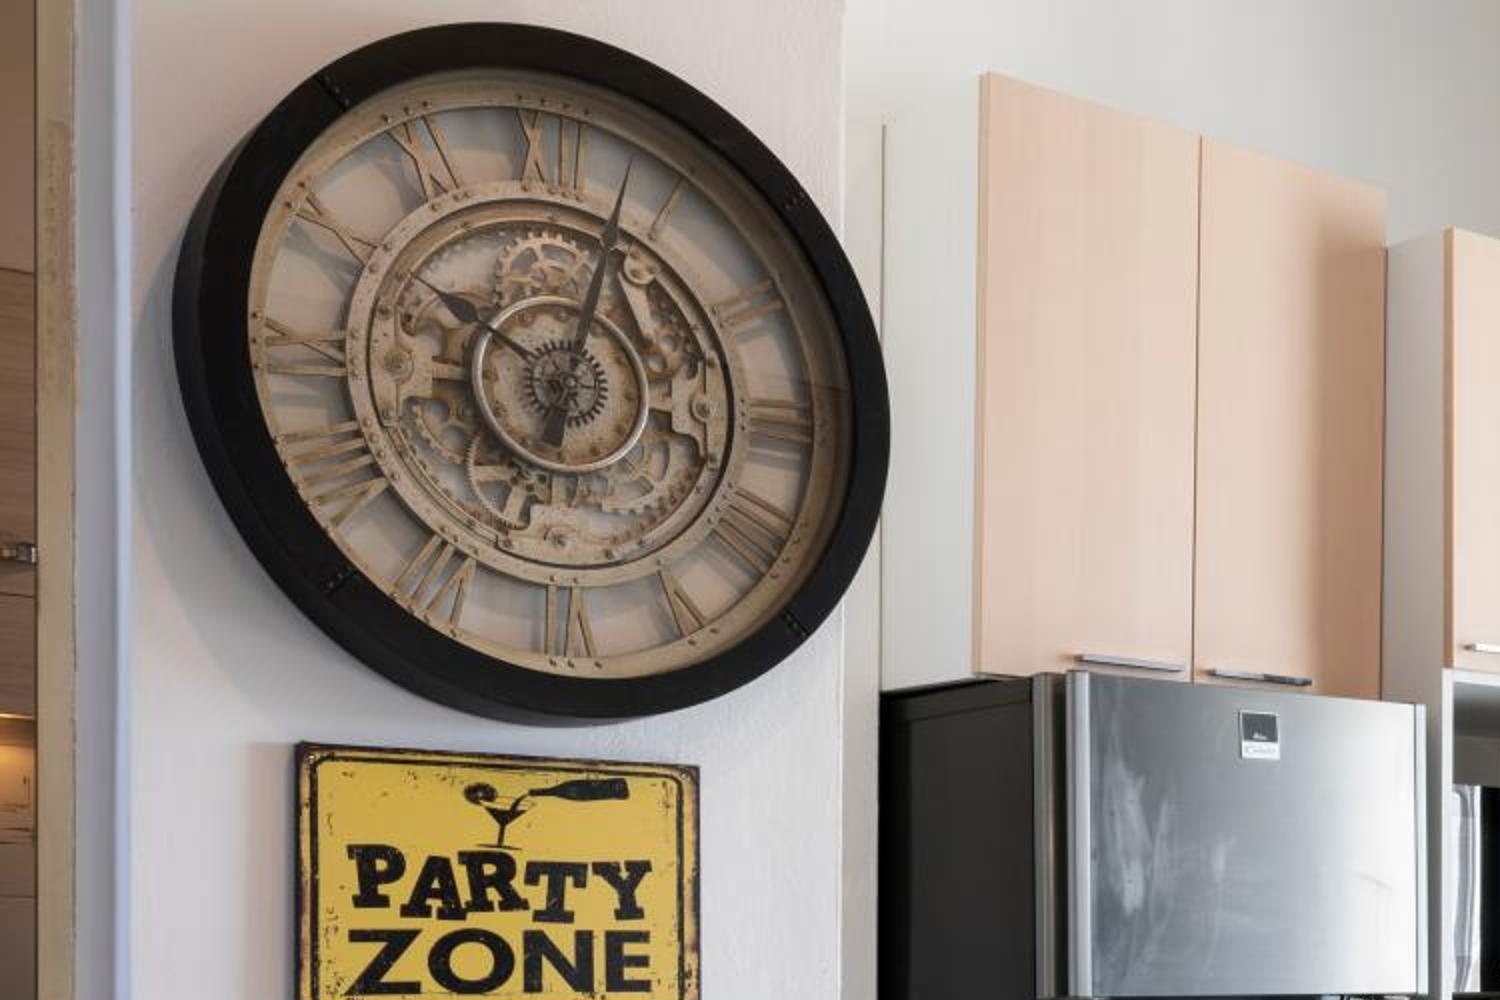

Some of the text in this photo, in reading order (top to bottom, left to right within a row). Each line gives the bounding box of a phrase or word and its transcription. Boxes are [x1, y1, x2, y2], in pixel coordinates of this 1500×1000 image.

[385, 116, 462, 202] XI
[516, 110, 592, 194] XII
[296, 195, 382, 267] X
[263, 315, 348, 377] IX
[390, 534, 477, 630] VII
[544, 585, 599, 658] VI
[346, 844, 653, 923] PARTY
[345, 928, 651, 996] ZONE
